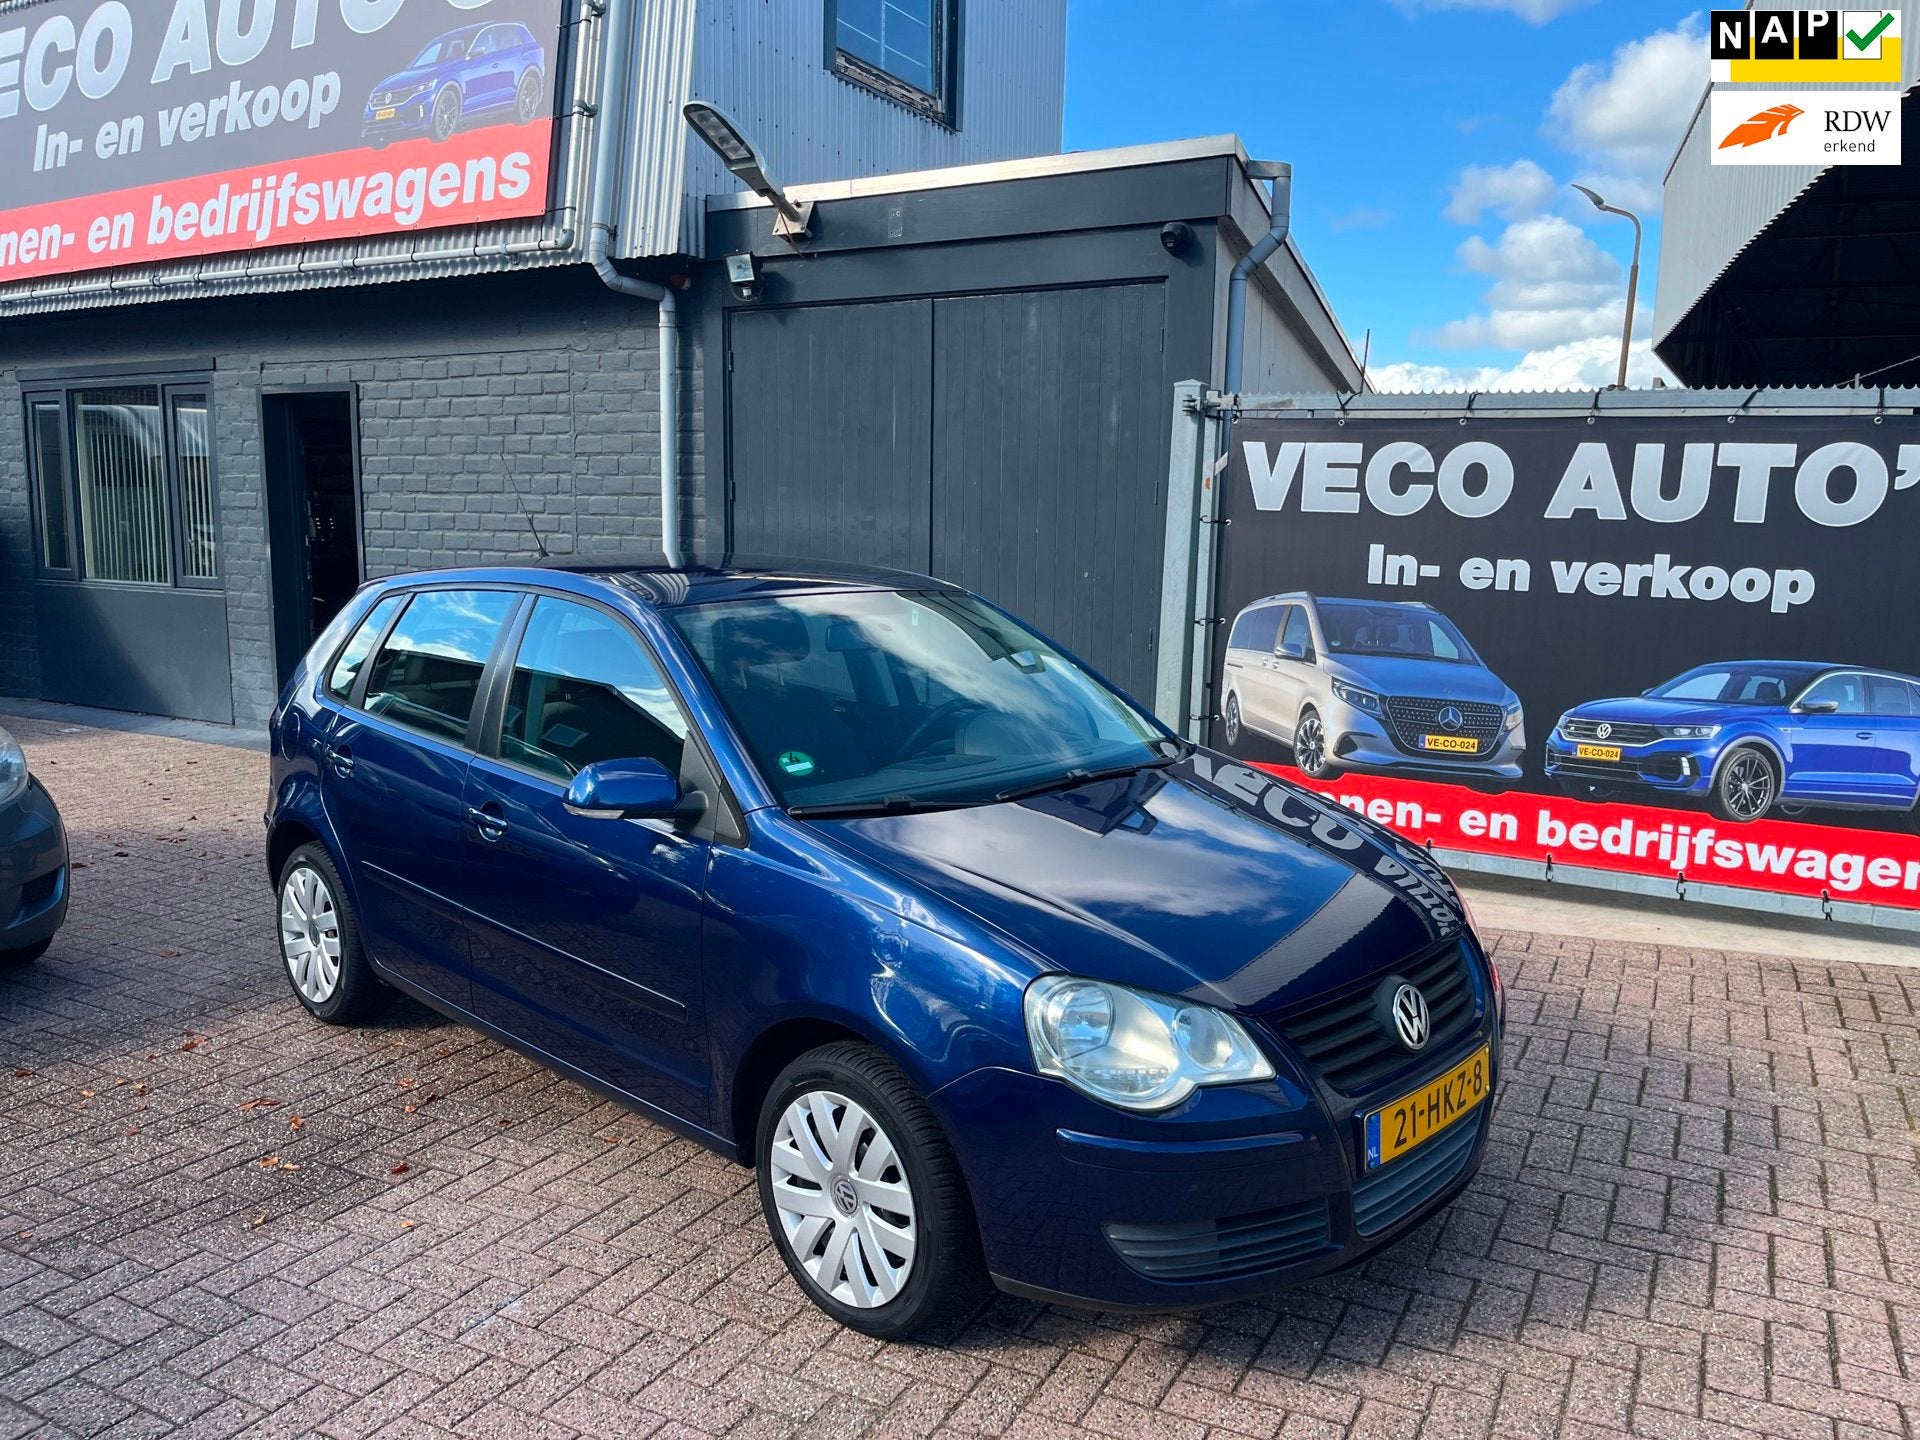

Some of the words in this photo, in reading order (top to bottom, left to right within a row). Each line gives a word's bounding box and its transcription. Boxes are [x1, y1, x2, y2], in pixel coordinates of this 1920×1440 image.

[33, 124, 83, 172] In-
[96, 115, 144, 159] en
[158, 70, 341, 147] verkoop
[87, 211, 135, 253] en
[147, 151, 531, 246] bedrijfswagens
[1243, 441, 1514, 518] VECO
[1367, 543, 1440, 587] In-
[1459, 553, 1530, 592] en
[1551, 554, 1816, 613] verkoop
[1427, 737, 1476, 750] VE-CO-024
[1579, 747, 1619, 759] VE-CO-024
[1459, 809, 1518, 840] en
[1393, 1060, 1482, 1149] 21-HKZ-8
[1367, 1147, 1379, 1160] NL
